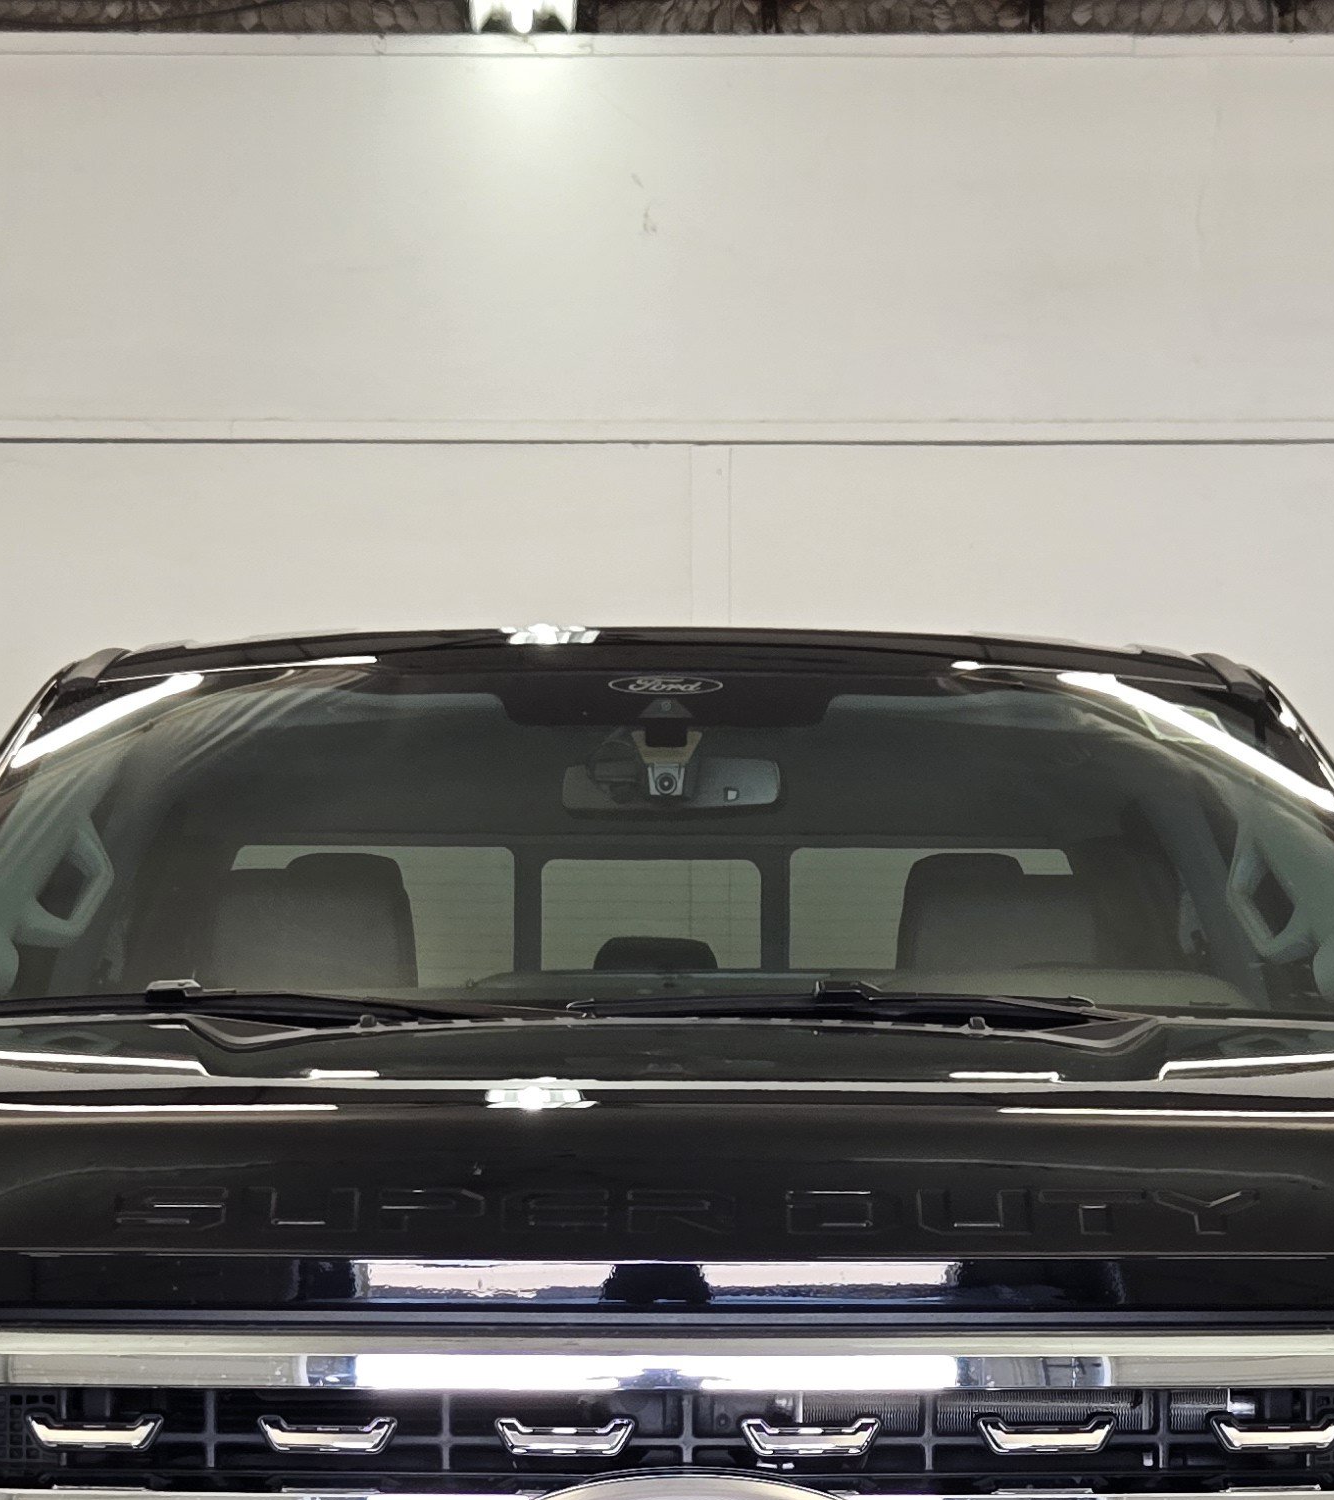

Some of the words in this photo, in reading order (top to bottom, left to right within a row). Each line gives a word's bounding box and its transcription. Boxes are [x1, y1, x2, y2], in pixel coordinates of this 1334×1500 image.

[628, 677, 701, 692] Ford
[111, 1184, 736, 1234] SUPER
[783, 1184, 1261, 1236] DUTY
